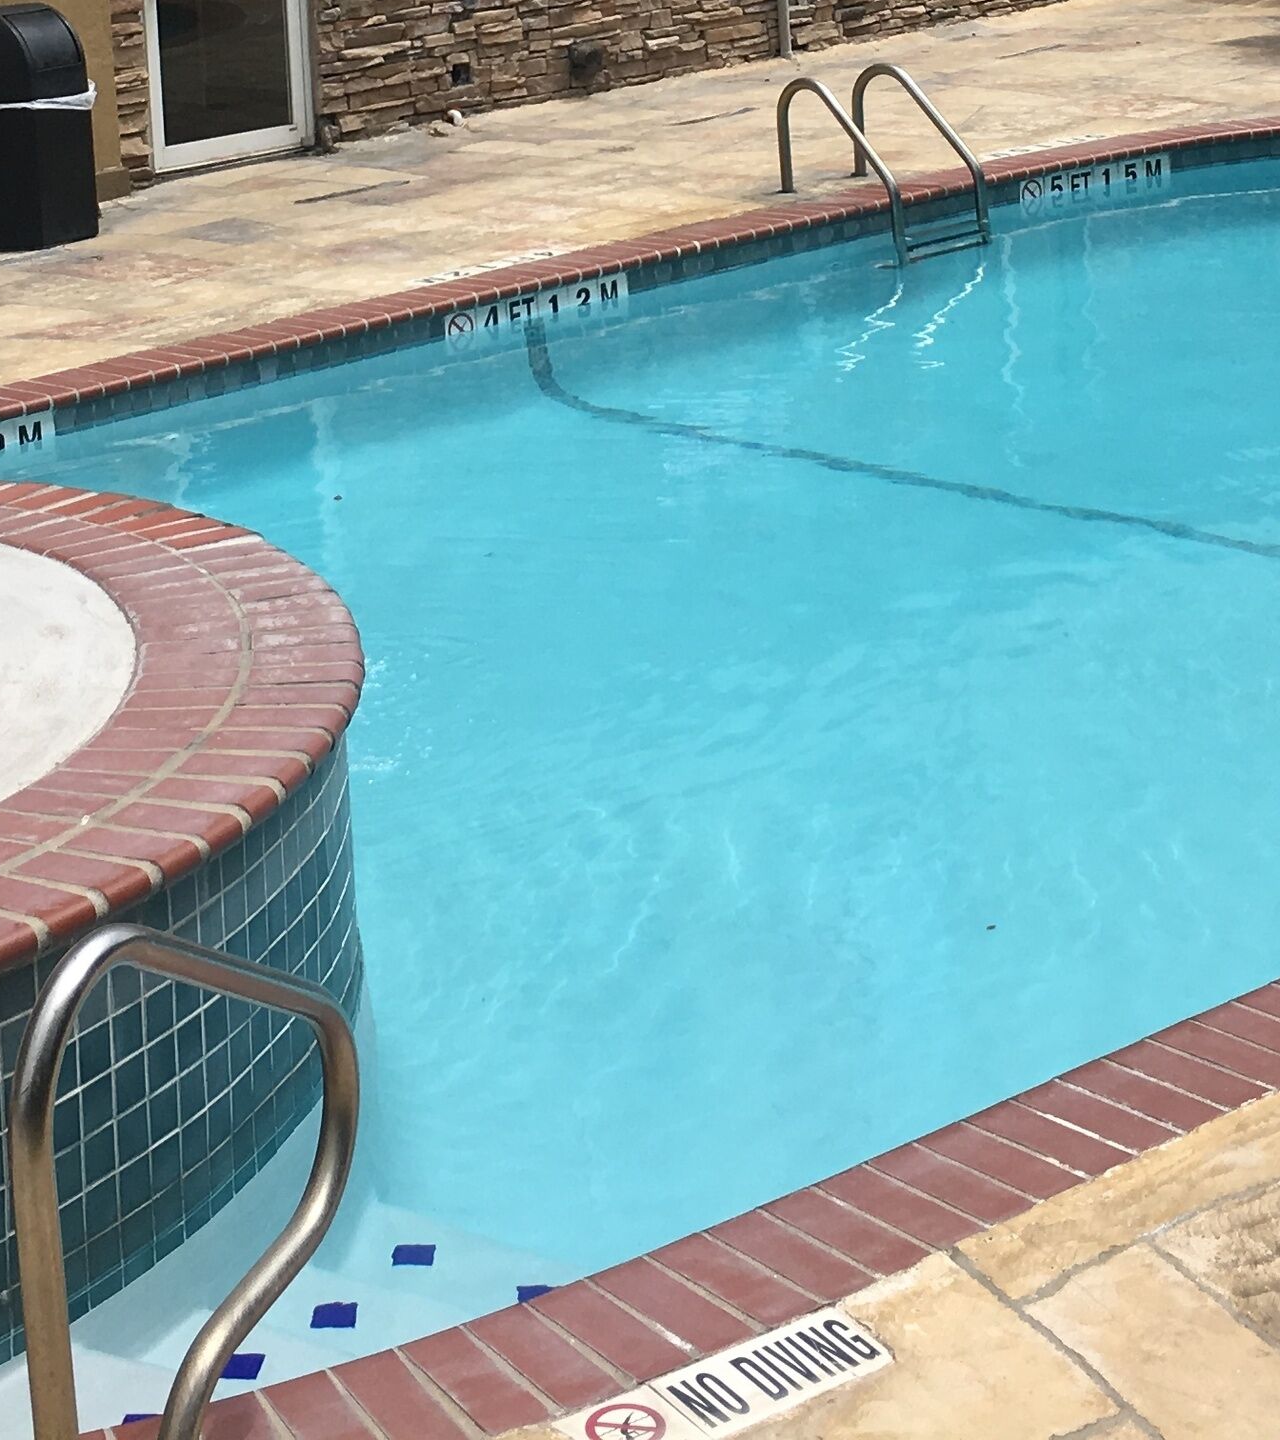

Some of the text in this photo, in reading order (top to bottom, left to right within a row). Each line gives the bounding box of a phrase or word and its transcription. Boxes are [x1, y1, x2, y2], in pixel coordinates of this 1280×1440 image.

[18, 420, 42, 446] M
[666, 1319, 881, 1428] NO DIVING
